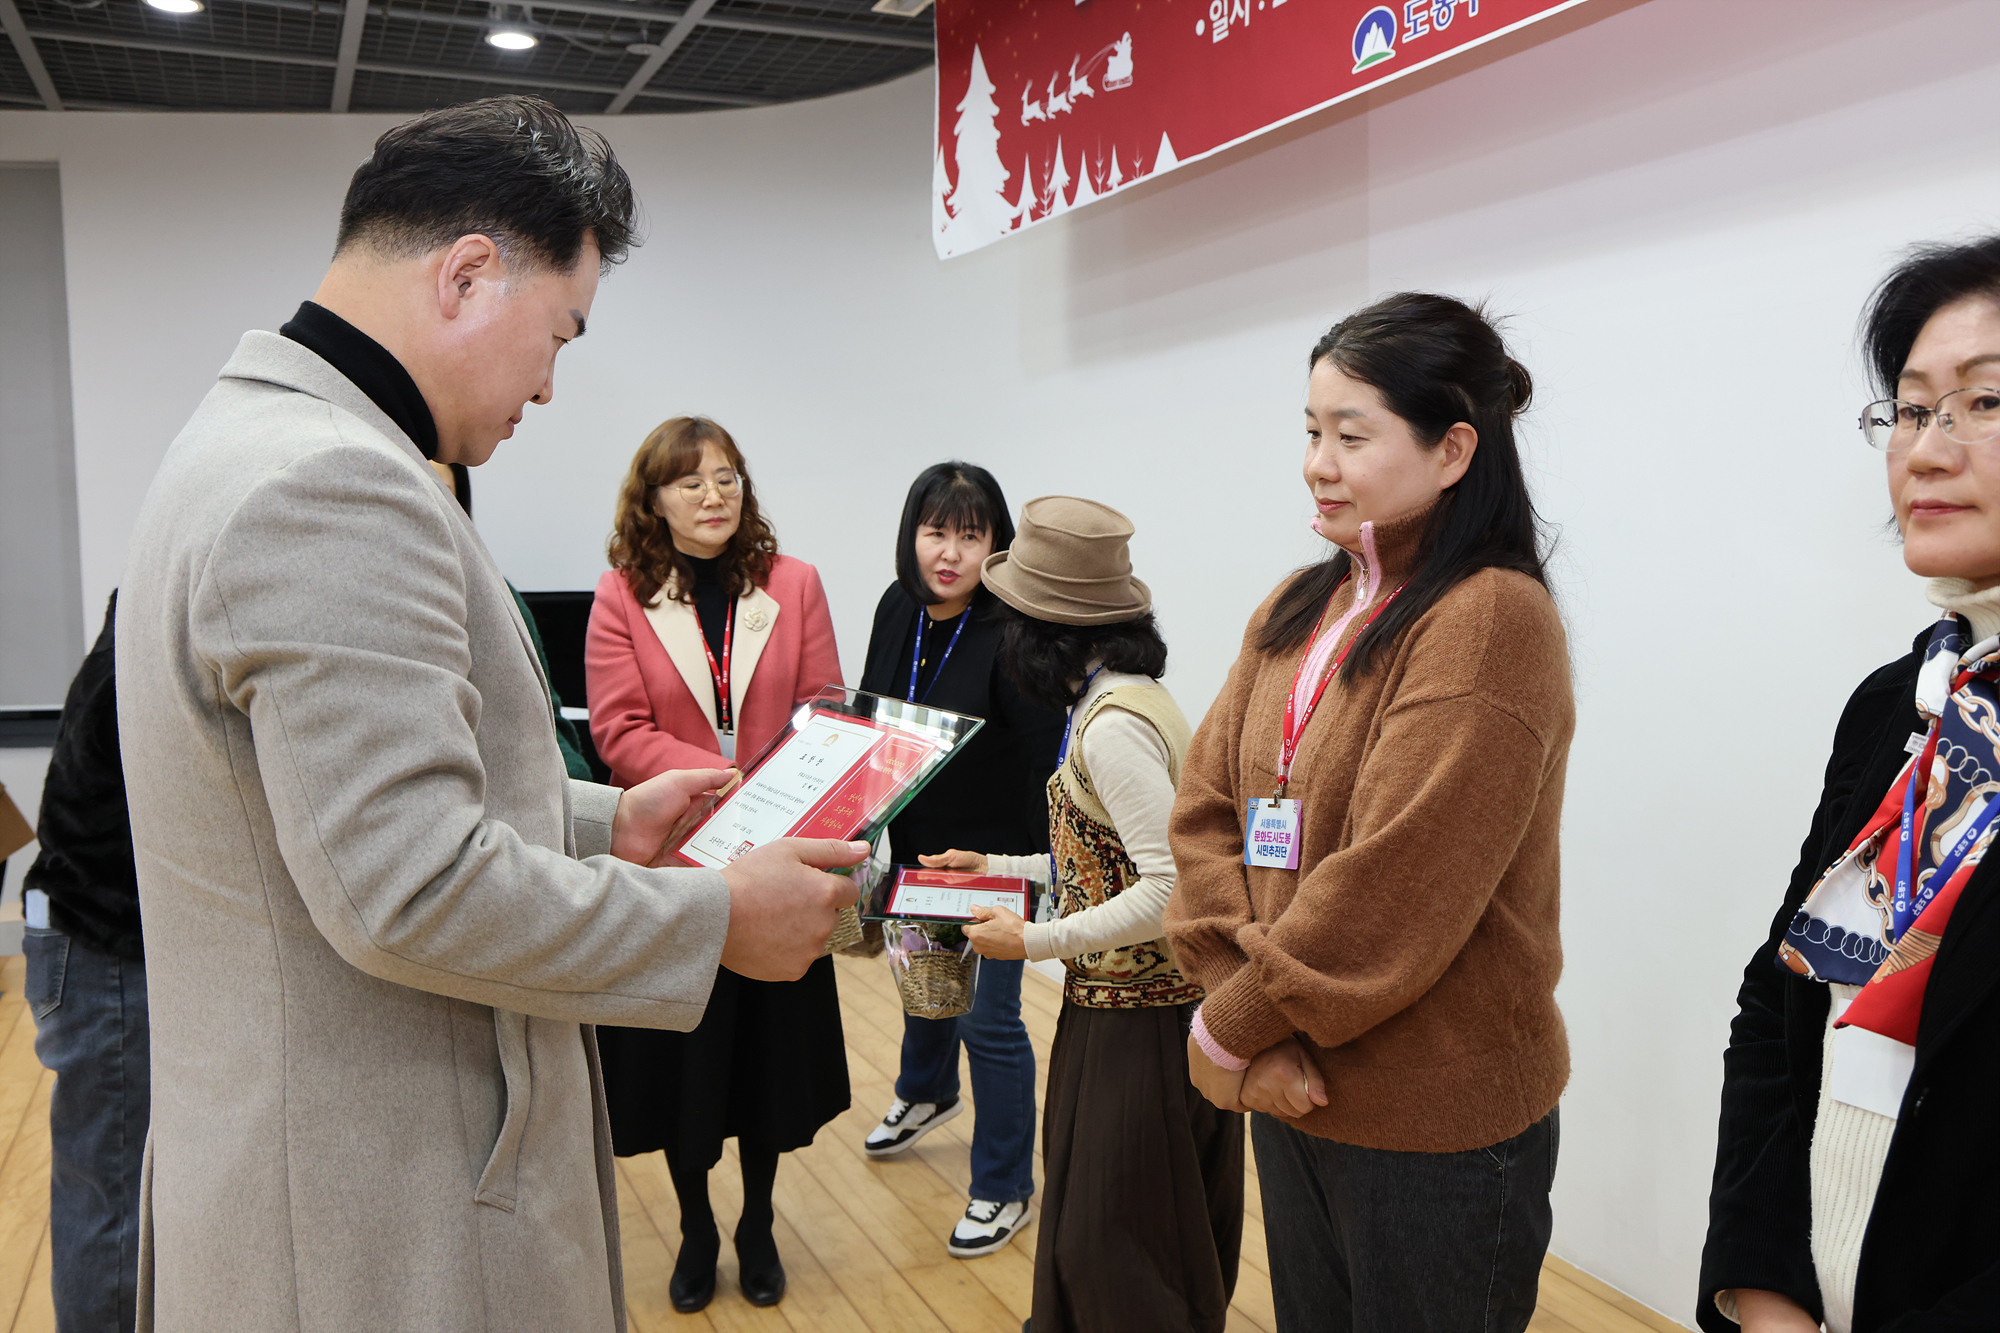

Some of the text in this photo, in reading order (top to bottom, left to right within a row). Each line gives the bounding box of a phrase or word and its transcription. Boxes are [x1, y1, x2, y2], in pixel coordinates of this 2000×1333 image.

[1260, 818, 1287, 830] 서울특별시
[1254, 830, 1291, 845] 문화도시도봉
[1256, 844, 1288, 858] 시민추진단
